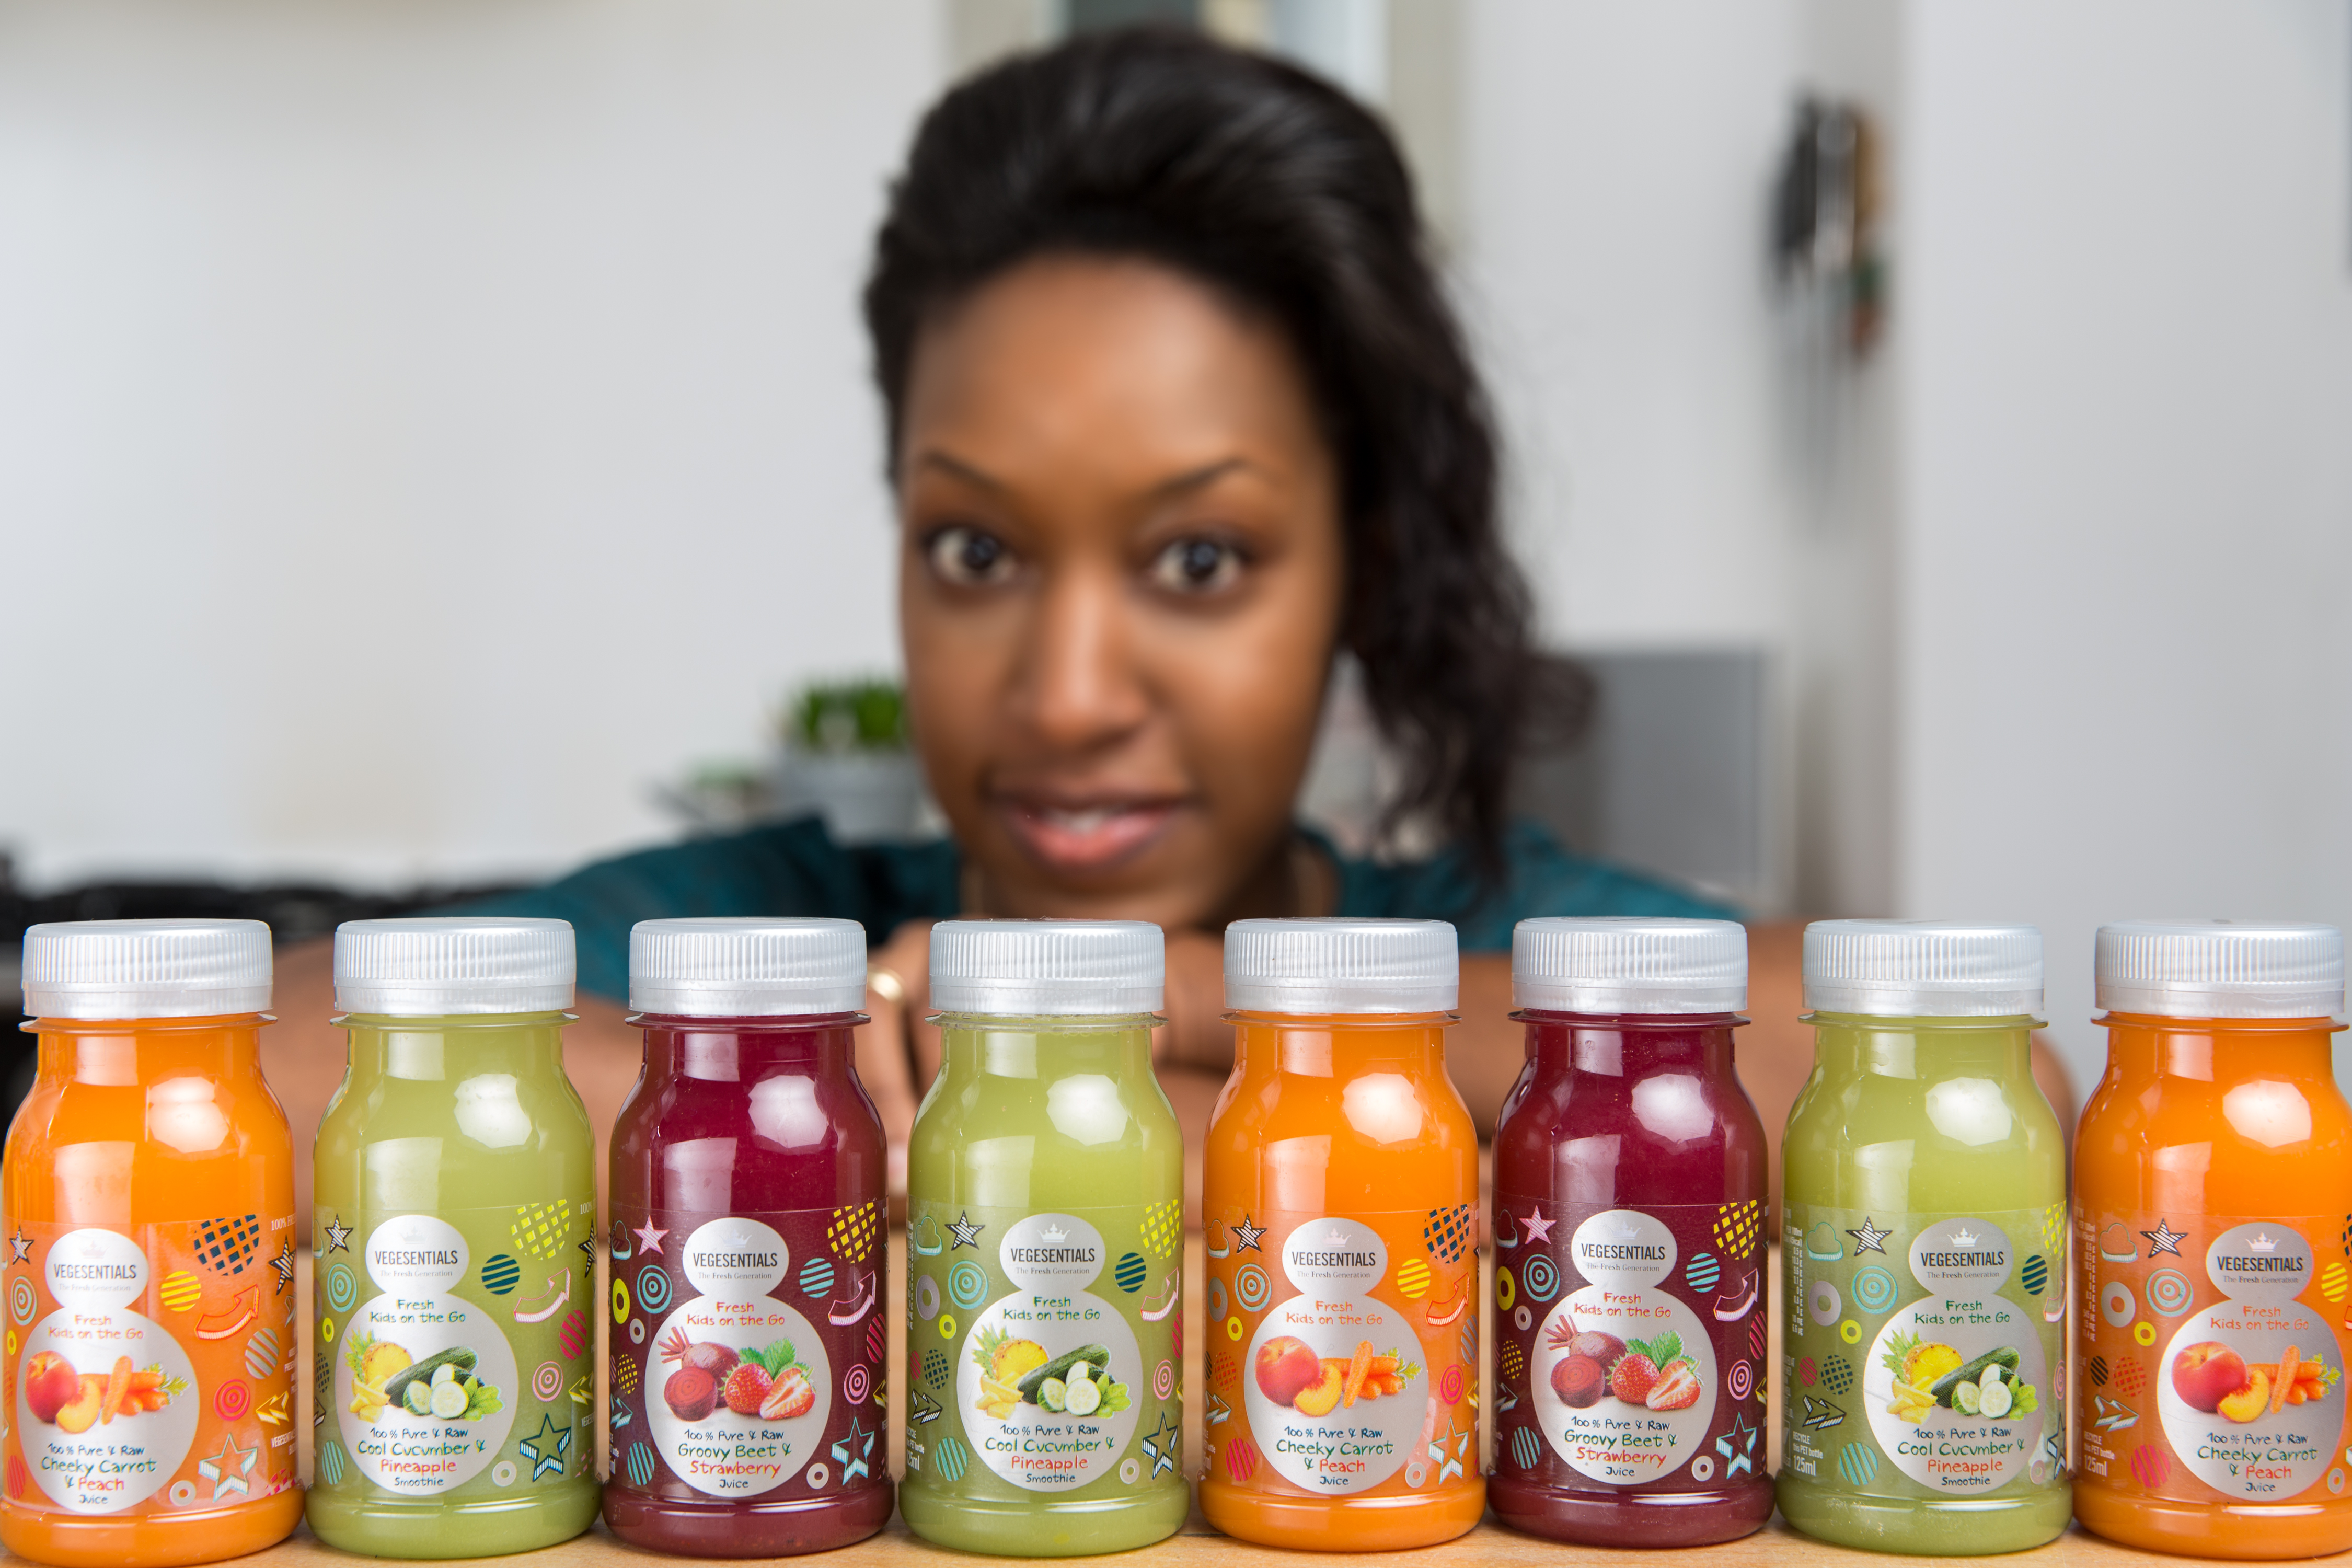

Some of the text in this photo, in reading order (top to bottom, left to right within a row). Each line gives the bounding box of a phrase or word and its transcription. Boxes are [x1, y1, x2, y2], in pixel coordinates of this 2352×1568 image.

[375, 1250, 458, 1265] VEGESENTIALS
[1011, 1248, 1095, 1263] VEGESENTIALS
[1581, 1243, 1666, 1260] VEGESENTIALS
[693, 1252, 778, 1268] VEGESENTIALS
[1292, 1252, 1376, 1267] VEGESENTIALS
[1920, 1251, 2005, 1267] VEGESENTIALS
[2217, 1256, 2304, 1272] VEGESENTIALS
[53, 1263, 137, 1279] VEGESENTIALS
[2222, 1275, 2238, 1283] The
[2238, 1275, 2261, 1284] Fresh
[396, 1299, 434, 1310] Fresh
[1033, 1296, 1071, 1308] Fresh
[1603, 1292, 1641, 1305] Fresh
[716, 1301, 754, 1313] Fresh
[1315, 1300, 1353, 1312] Fresh
[1574, 1303, 1671, 1318] Kids on the Go
[1945, 1300, 1982, 1311] Fresh
[2243, 1305, 2281, 1317] Fresh
[74, 1315, 111, 1326] Fresh
[368, 1311, 466, 1323] Kids on the Go
[686, 1314, 785, 1327] Kids on the Go
[1002, 1308, 1100, 1321] Kids on the Go
[1286, 1313, 1383, 1325] Kids on the Go
[1915, 1312, 2010, 1325] Kids on the Go
[2210, 1317, 2309, 1330] Kids on the Go
[48, 1327, 143, 1340] Kids on the Go
[1035, 1424, 1062, 1436] Pure
[1078, 1424, 1100, 1435] Raw
[1605, 1419, 1631, 1430] Pure
[1647, 1420, 1670, 1431] Raw
[401, 1428, 428, 1439] Pure
[445, 1427, 468, 1438] Raw
[718, 1430, 744, 1442] Pure
[762, 1429, 784, 1441] Raw
[1318, 1427, 1344, 1438] Pure
[1361, 1427, 1383, 1438] Raw
[1950, 1428, 1976, 1439] Pure
[1991, 1427, 2011, 1437] Raw
[2244, 1433, 2272, 1445] Pure
[2287, 1433, 2307, 1444] Raw
[984, 1437, 1018, 1452] Cool
[1022, 1438, 1101, 1453] Cucumber
[1564, 1429, 1617, 1451] Groovy
[1622, 1433, 1663, 1448] Beet
[77, 1444, 103, 1456] Pure
[120, 1445, 145, 1456] Raw
[356, 1440, 386, 1456] Cool
[390, 1442, 471, 1457] Cucumber
[678, 1443, 731, 1463] Groovy
[735, 1444, 777, 1458] Beet
[1276, 1439, 1393, 1459] Cheeky Carrot
[1800, 1445, 1808, 1455] PET
[1808, 1447, 1824, 1459] bottle
[1897, 1441, 1932, 1456] Cool
[1938, 1442, 2013, 1457] Cucumber
[1576, 1446, 1667, 1468] Strawberry
[2197, 1445, 2318, 1467] Cheeky Carrot
[40, 1456, 157, 1478] Cheeky Carrot
[380, 1459, 457, 1477] Pineapple
[689, 1461, 781, 1479] Strawberry
[1011, 1455, 1088, 1473] Pineapple
[1319, 1459, 1365, 1473] Peach
[1793, 1455, 1816, 1477] 125ml
[1928, 1458, 2003, 1475] Pineapple
[2084, 1455, 2107, 1477] 125ml
[1025, 1473, 1076, 1483] Smoothie
[1605, 1466, 1635, 1477] Juice
[2246, 1466, 2292, 1479] Peach
[77, 1477, 124, 1491] Peach
[394, 1477, 444, 1486] Smoothie
[719, 1479, 749, 1489] Juice
[1319, 1476, 1348, 1485] Juice
[1941, 1476, 1990, 1486] Smoothie
[2245, 1482, 2276, 1492] Juice
[79, 1494, 108, 1504] Juice
